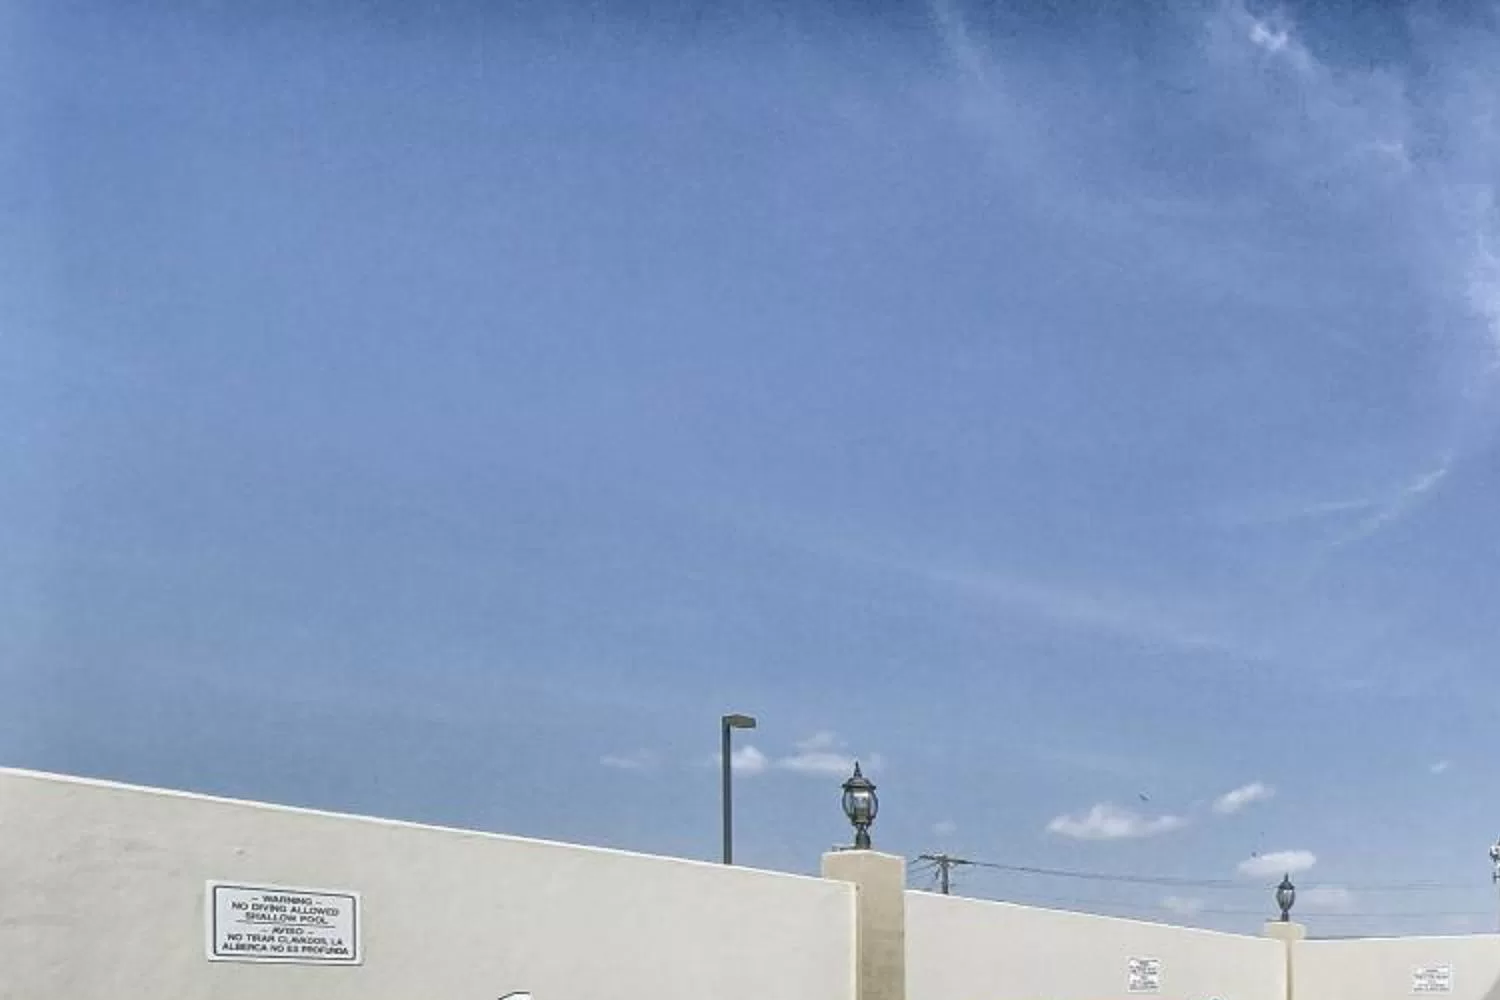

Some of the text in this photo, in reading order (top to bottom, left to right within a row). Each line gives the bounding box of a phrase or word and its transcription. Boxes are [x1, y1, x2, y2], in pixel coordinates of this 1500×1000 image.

[232, 902, 248, 911] NO
[252, 903, 287, 913] DIVING
[227, 933, 243, 941] NO
